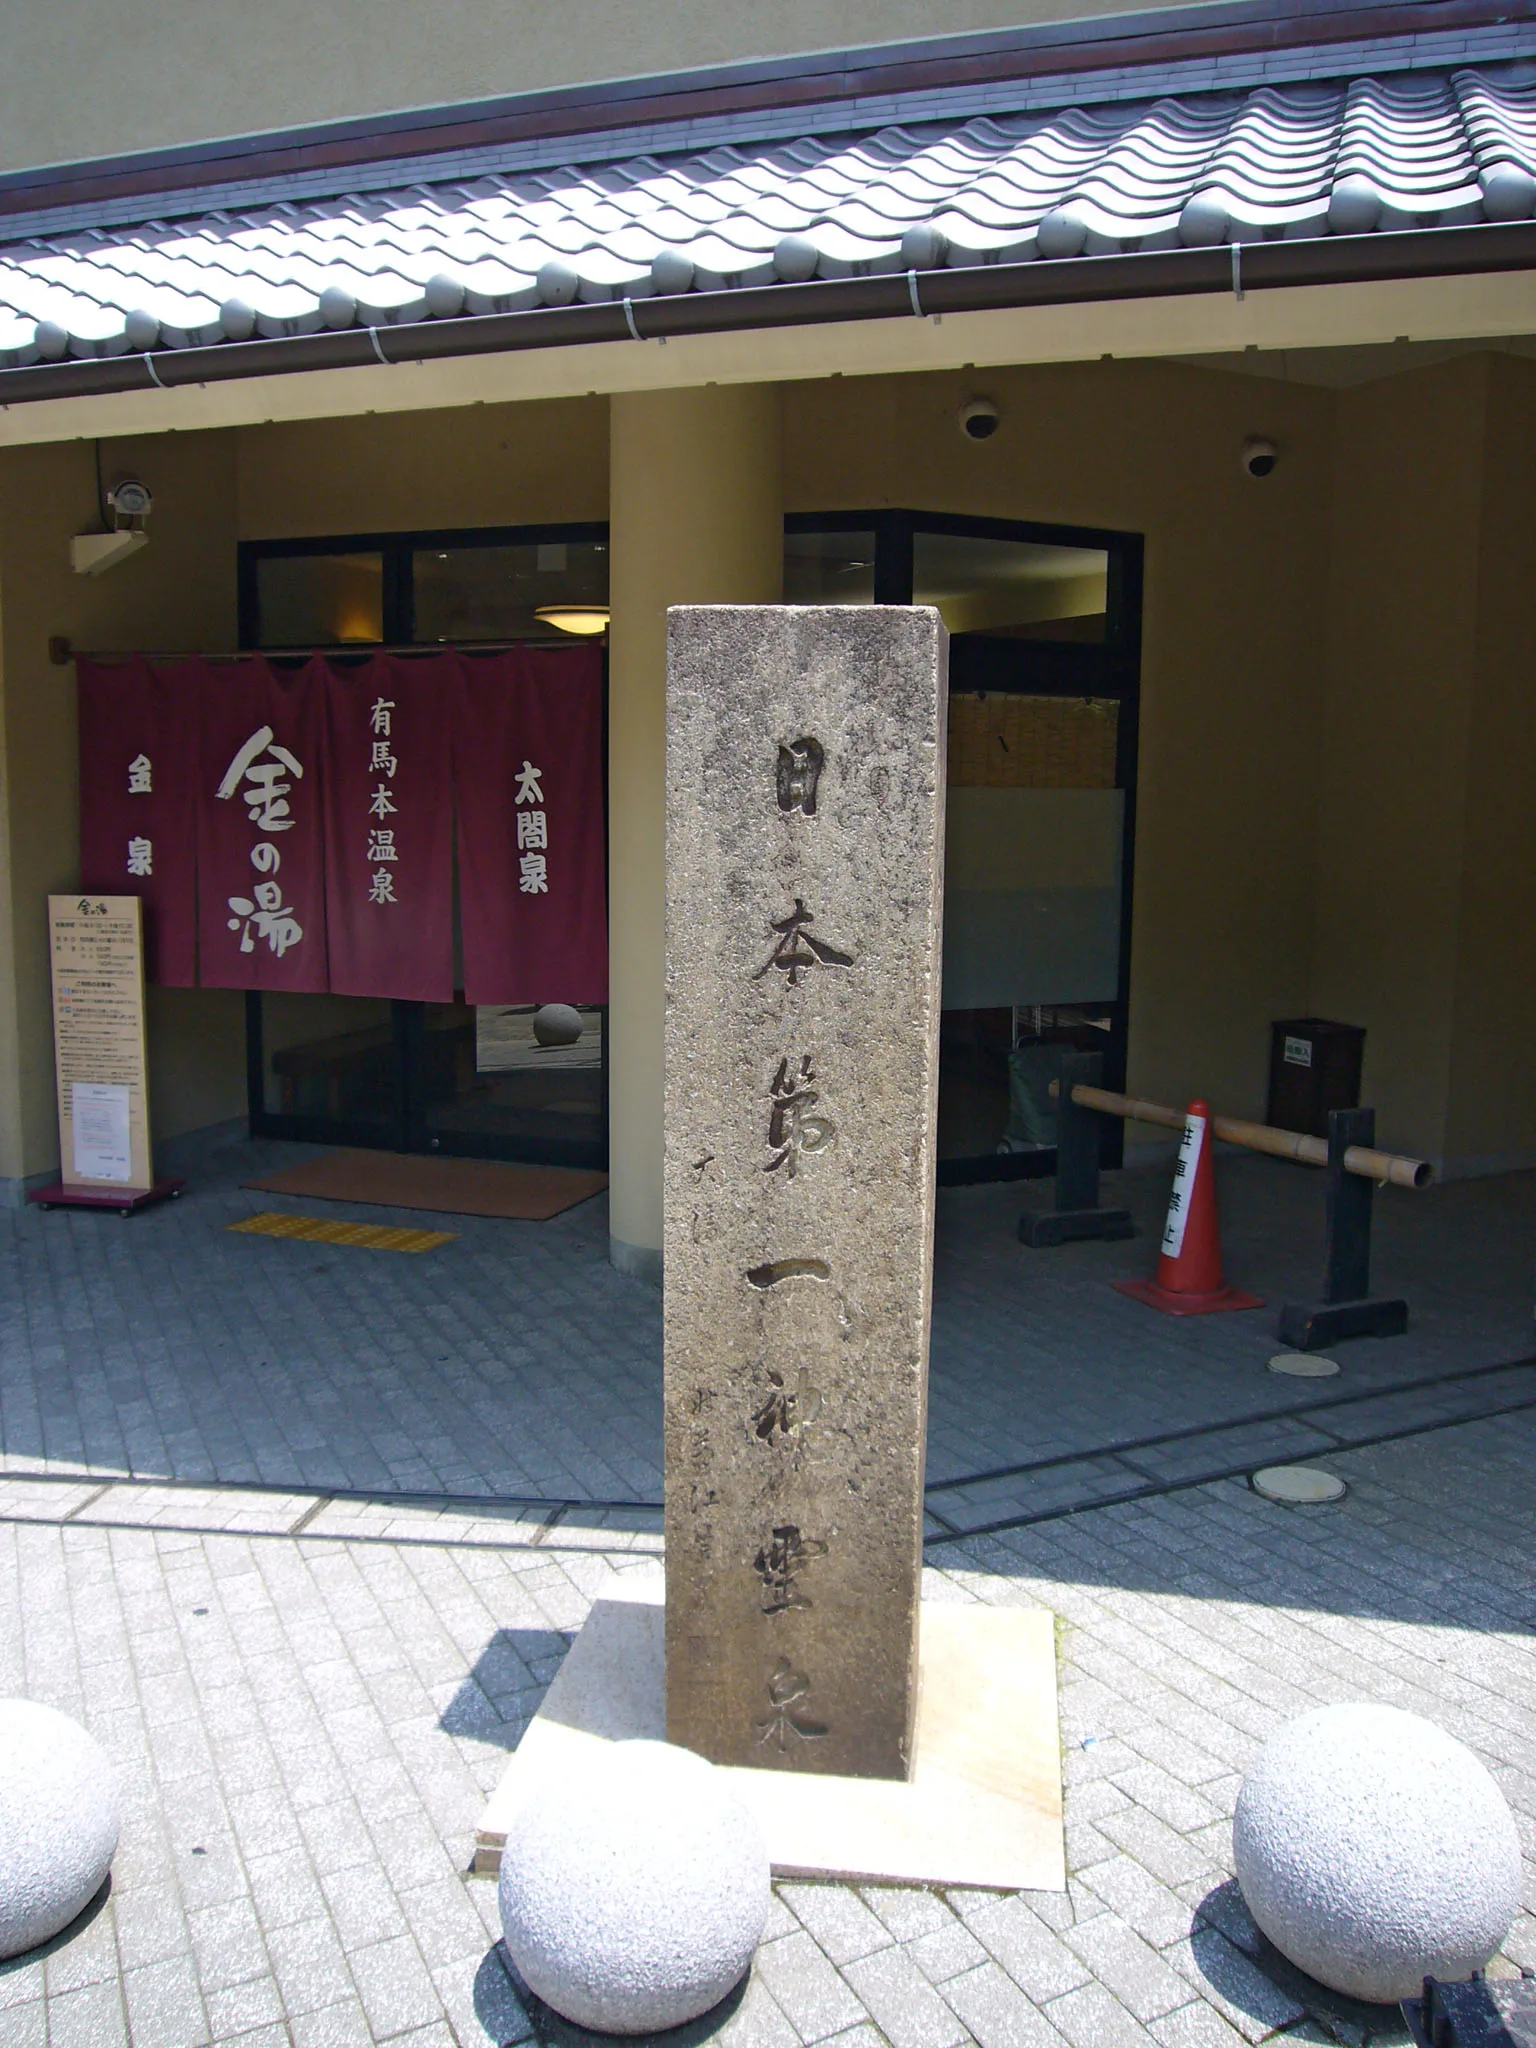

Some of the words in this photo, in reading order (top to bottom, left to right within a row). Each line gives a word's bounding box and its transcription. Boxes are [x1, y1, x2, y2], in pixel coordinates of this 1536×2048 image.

[127, 754, 153, 876] 金泉
[215, 725, 304, 958] 金の湯
[367, 697, 399, 904] 有馬本温泉
[514, 760, 549, 894] 太閤泉
